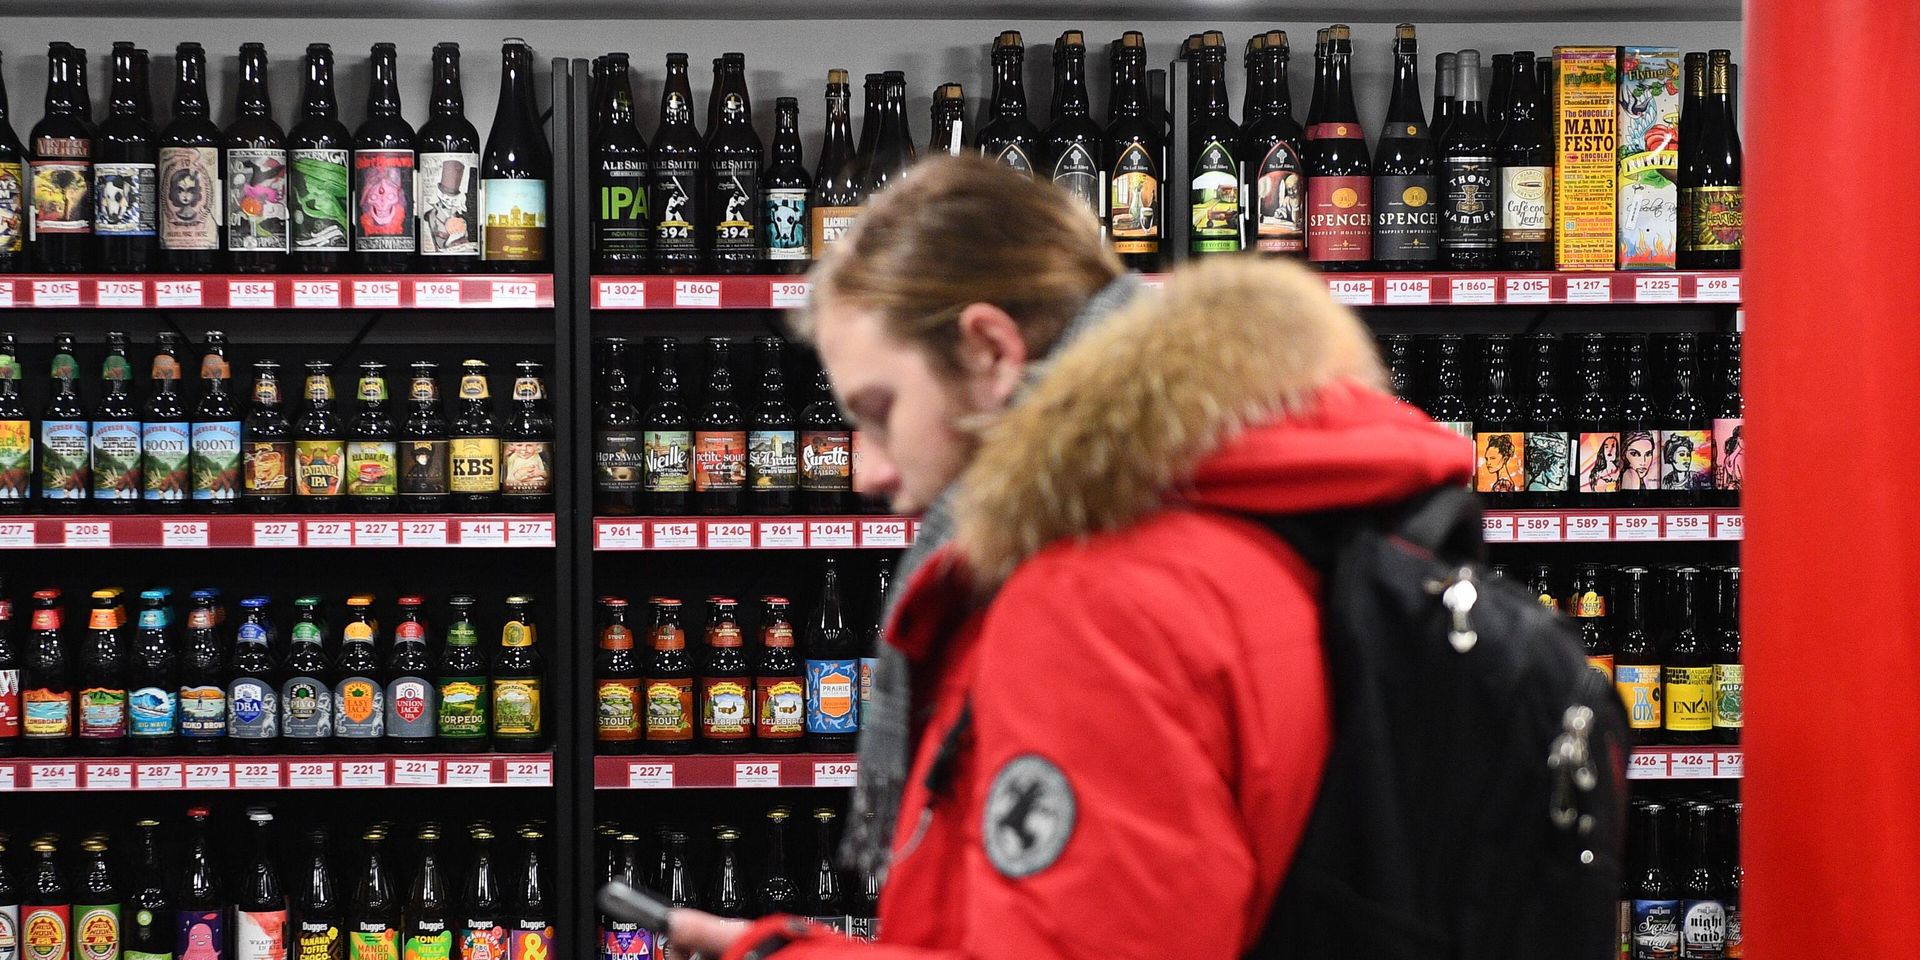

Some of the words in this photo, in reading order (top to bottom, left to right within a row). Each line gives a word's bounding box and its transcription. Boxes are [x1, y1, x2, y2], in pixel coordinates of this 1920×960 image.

[1629, 69, 1665, 81] Flying
[1565, 110, 1577, 118] The
[1578, 109, 1614, 118] CHOCOLATE
[1564, 118, 1614, 135] MANI
[1564, 135, 1614, 152] FESTO
[1449, 174, 1491, 187] THOR'S
[1605, 179, 1613, 188] 3
[601, 186, 649, 220] IPA
[1507, 200, 1529, 216] Café
[1529, 205, 1550, 216] con
[1310, 214, 1372, 227] SPENCER
[1444, 209, 1496, 224] HAMMER
[1519, 211, 1545, 227] Leche
[660, 227, 688, 239] 394
[720, 227, 749, 239] 394
[1708, 280, 1728, 289] 698
[782, 285, 805, 295] 930
[145, 440, 185, 450] BOONT
[196, 440, 235, 450] BOONT
[696, 451, 722, 464] petite
[803, 445, 849, 472] Surette
[452, 458, 494, 476] KBS
[310, 477, 328, 487] IPA
[1527, 519, 1550, 529] 589
[1576, 518, 1599, 528] 589
[1626, 518, 1648, 528] 589
[1676, 517, 1698, 527] 558
[1, 525, 22, 534] 277
[76, 525, 99, 535] 208
[174, 524, 197, 534] 208
[264, 525, 287, 534] 227
[317, 525, 340, 534] 227
[365, 524, 387, 533] 227
[412, 524, 435, 533] 227
[473, 524, 491, 534] 411
[518, 524, 540, 533] 277
[610, 526, 631, 536] 961
[771, 525, 792, 535] 961
[236, 702, 260, 712] DBA
[291, 700, 316, 708] PIVO
[440, 715, 485, 724] TORPEDO
[599, 716, 632, 726] STOUT
[648, 716, 680, 726] STOUT
[182, 721, 202, 729] KOKO
[1634, 755, 1656, 766] 426
[1681, 755, 1703, 765] 426
[42, 767, 65, 776] 264
[97, 767, 120, 776] 248
[148, 766, 170, 776] 287
[196, 766, 219, 776] 279
[245, 766, 268, 775] 232
[300, 765, 323, 775] 228
[352, 765, 374, 775] 221
[406, 763, 427, 772] 221
[456, 765, 479, 774] 227
[518, 765, 538, 774] 221
[639, 766, 662, 776] 227
[746, 765, 768, 775] 248
[302, 921, 328, 932] Dugges
[360, 921, 386, 932] Dugges
[419, 920, 445, 931] Dugges
[468, 919, 494, 930] Dugges
[520, 920, 546, 930] Dugges
[612, 921, 638, 932] Dugges
[1691, 915, 1722, 931] night
[1694, 930, 1720, 942] raid
[300, 937, 331, 946] BANANA
[302, 945, 329, 954] TOFFEE
[358, 944, 389, 952] MANGO
[611, 952, 640, 960] BLACK
